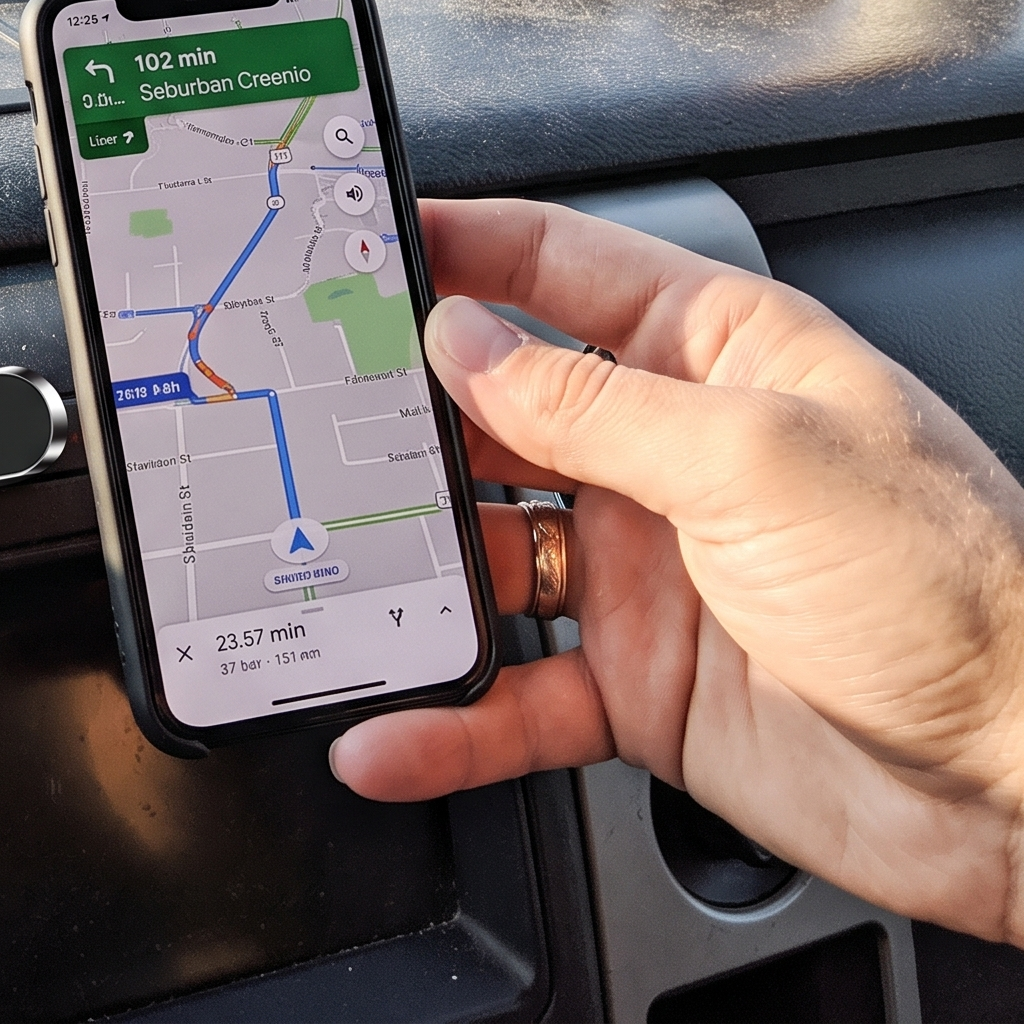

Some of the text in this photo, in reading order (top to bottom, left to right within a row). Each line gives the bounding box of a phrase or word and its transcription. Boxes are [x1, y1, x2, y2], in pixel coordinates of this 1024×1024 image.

[67, 14, 99, 27] 12:25
[134, 47, 217, 73] 102 min
[139, 66, 312, 102] Seburban Creenio
[179, 454, 192, 465] St
[216, 622, 307, 652] 23.57 min
[220, 661, 236, 676] 37
[274, 651, 297, 666] 151
